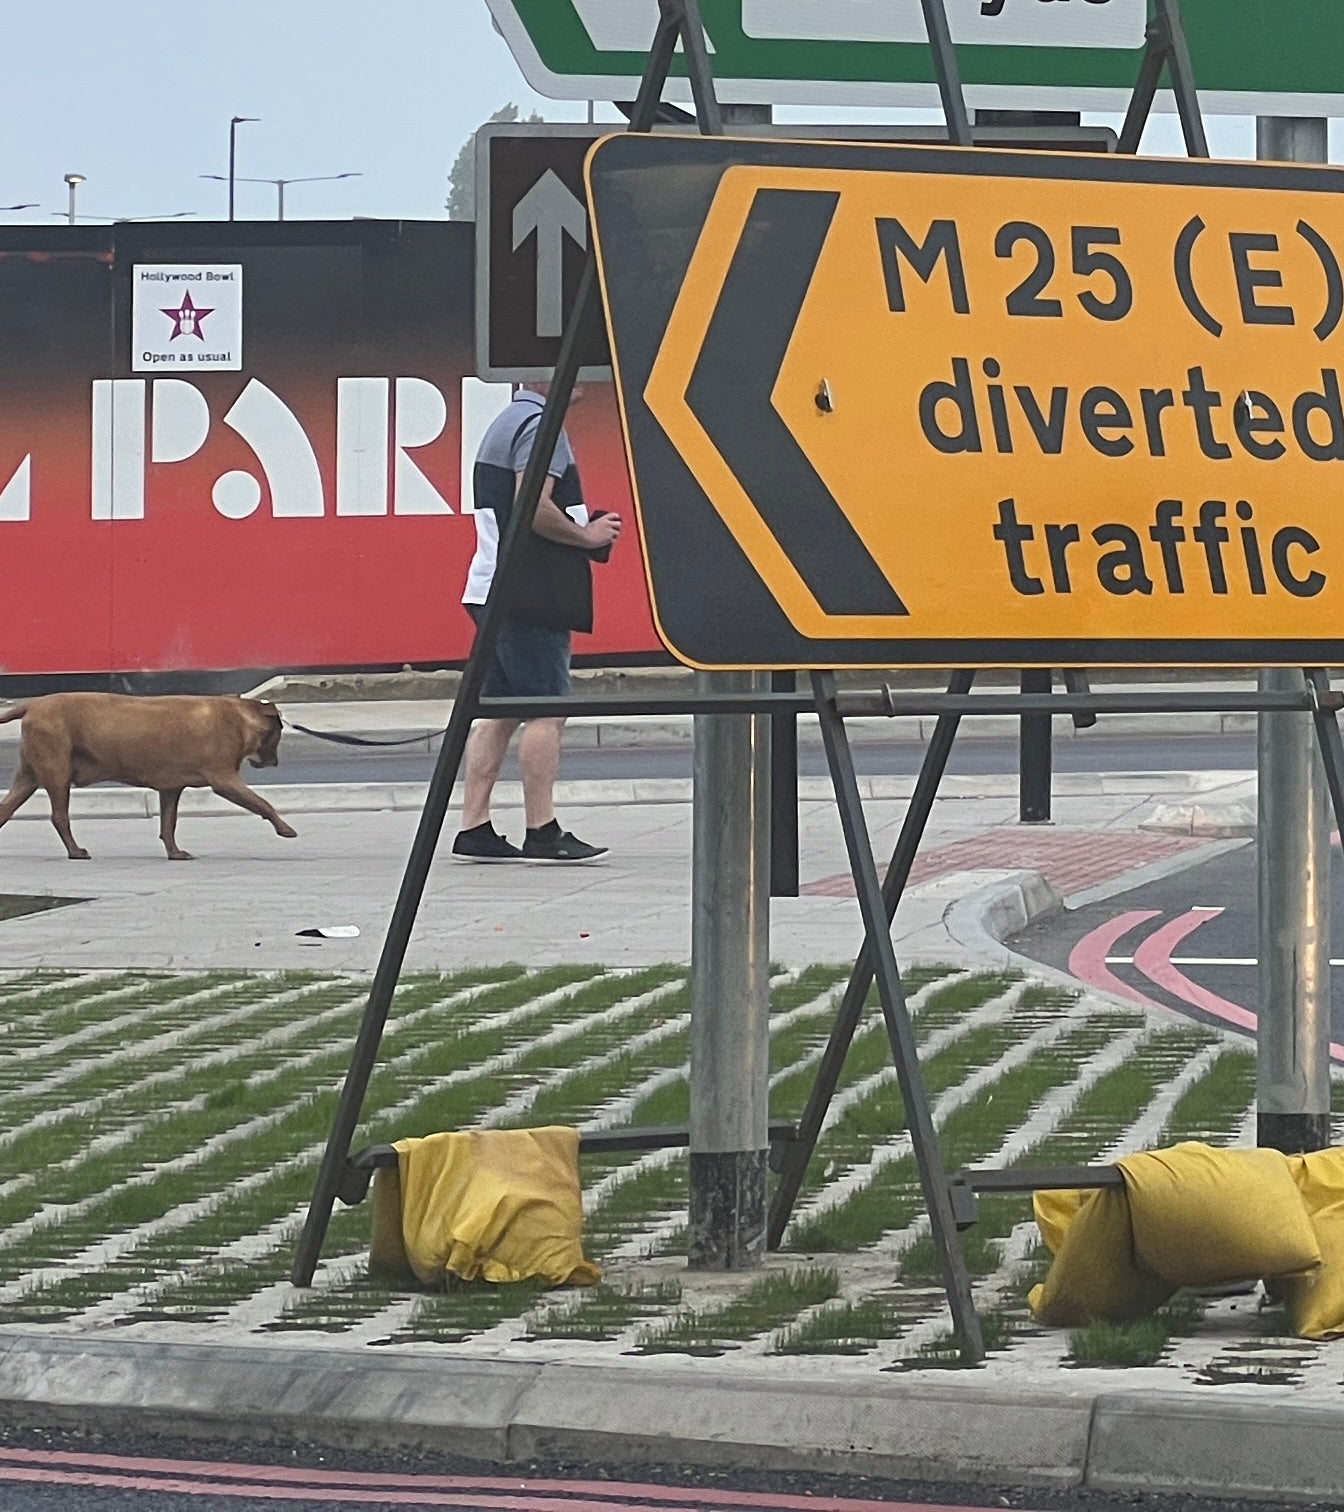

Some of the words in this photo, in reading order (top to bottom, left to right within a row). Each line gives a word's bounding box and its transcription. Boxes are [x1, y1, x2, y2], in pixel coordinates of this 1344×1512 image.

[141, 272, 202, 282] Hollywood
[206, 272, 234, 281] Bowl
[1174, 214, 1344, 341] (E)
[143, 351, 175, 363] Open
[180, 353, 193, 362] as
[198, 351, 231, 362] usual
[993, 498, 1327, 597] traffic
